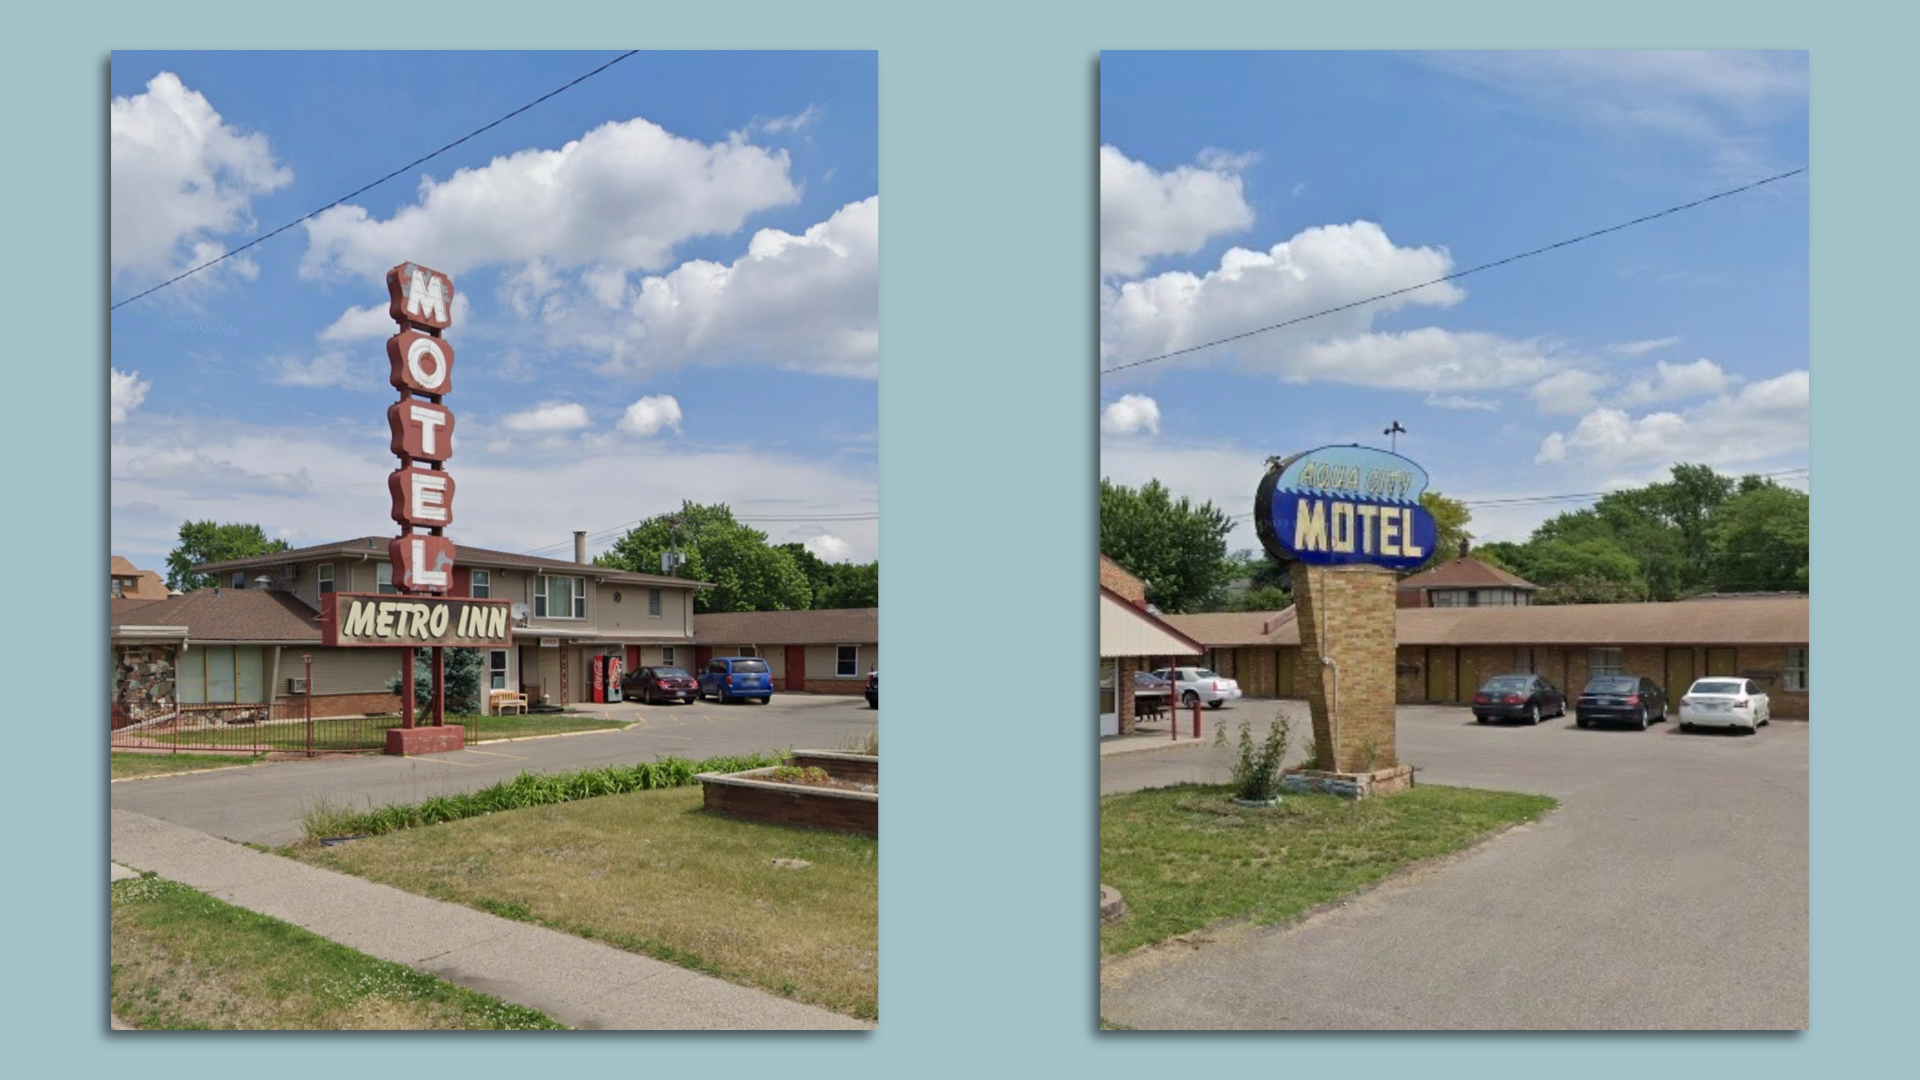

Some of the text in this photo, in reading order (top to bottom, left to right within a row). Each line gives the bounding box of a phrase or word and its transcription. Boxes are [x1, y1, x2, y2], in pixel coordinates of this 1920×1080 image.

[406, 268, 447, 587] MOTEL
[1300, 462, 1412, 496] AQUA CITY
[1294, 499, 1424, 557] MOTEL
[344, 601, 507, 640] METRO INN
[593, 660, 603, 690] Coca-Cola
